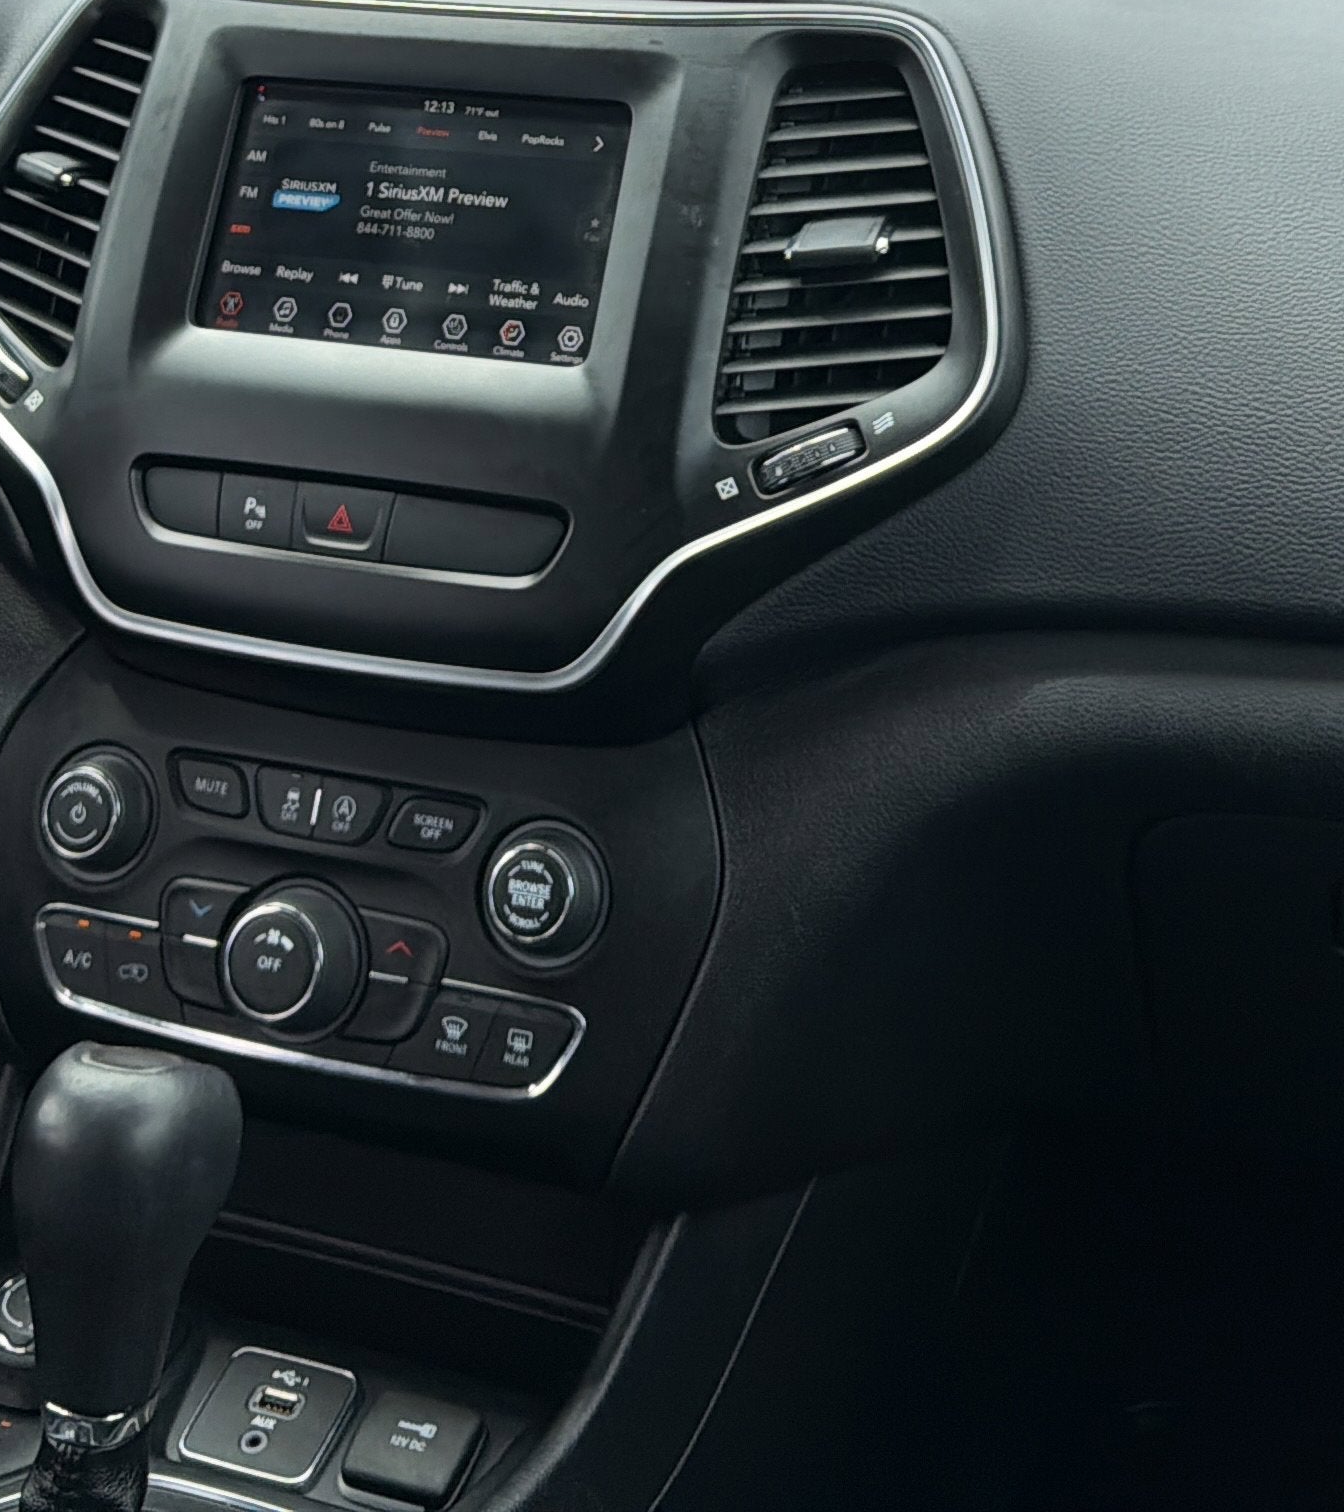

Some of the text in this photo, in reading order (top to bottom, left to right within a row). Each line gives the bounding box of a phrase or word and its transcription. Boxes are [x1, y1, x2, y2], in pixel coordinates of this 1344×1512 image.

[424, 99, 456, 115] 12:13
[246, 149, 267, 162] AM
[369, 161, 446, 179] Entertainment
[239, 186, 258, 199] FM
[281, 178, 336, 193] SIRIUSXM
[366, 181, 508, 208] 1 SiriusXM Preview
[360, 204, 455, 225] Great Offer Now!
[356, 221, 435, 240] 844-711-8800
[221, 259, 262, 277] Browse
[275, 265, 314, 284] Replay
[396, 276, 424, 292] Tune
[493, 278, 528, 295] Traffic
[488, 294, 539, 311] Weather
[552, 292, 590, 308] Audio
[194, 776, 229, 796] MUTE
[330, 820, 351, 833] OFF
[413, 813, 454, 832] SCREEN
[420, 827, 442, 840] OFF
[507, 878, 552, 899] BROWSE
[511, 893, 545, 910] ENTER
[63, 948, 92, 970] A/C
[257, 955, 283, 973] OFF
[435, 1038, 468, 1056] FRONT
[502, 1051, 530, 1068] REAR
[250, 1415, 278, 1431] AUX
